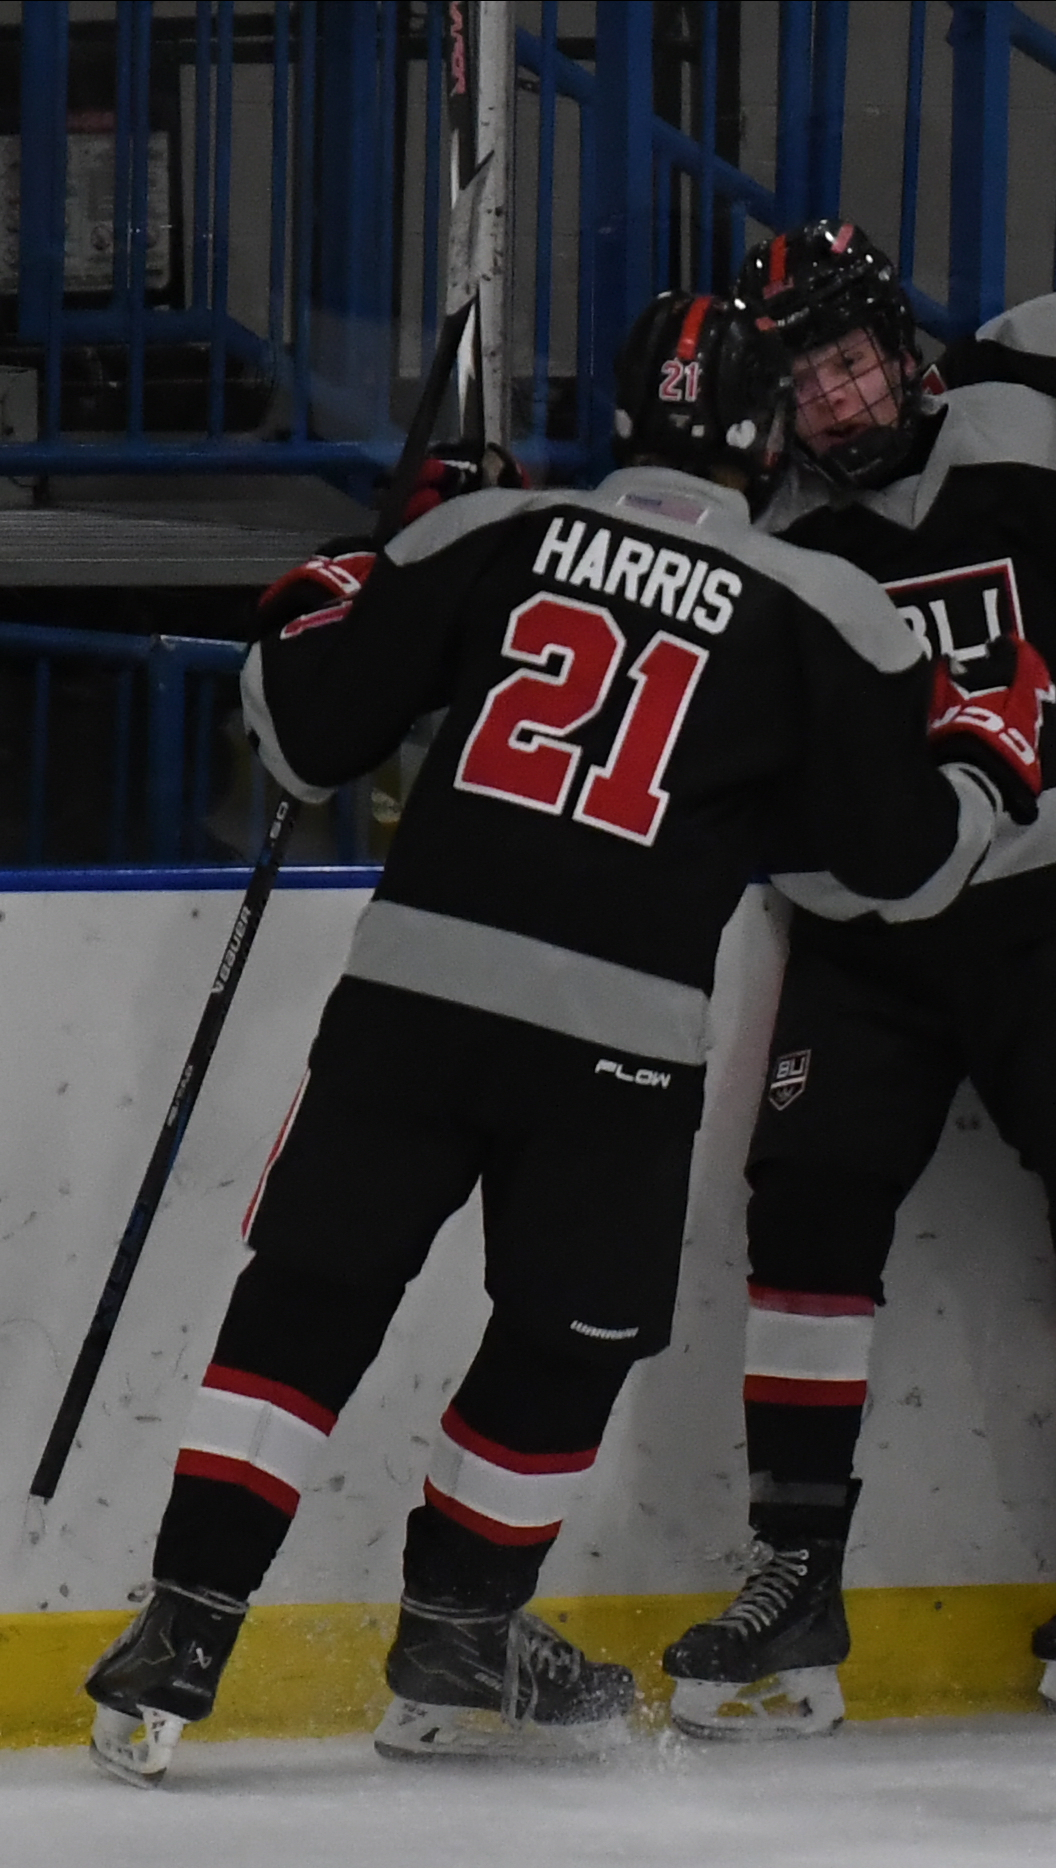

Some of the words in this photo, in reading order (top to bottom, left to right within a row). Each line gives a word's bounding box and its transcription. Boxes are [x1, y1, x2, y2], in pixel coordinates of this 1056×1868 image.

[658, 359, 701, 402] 21
[532, 516, 743, 635] HARRIS
[452, 589, 711, 849] 21
[217, 904, 252, 983] BAUER
[594, 1058, 672, 1090] FLOW
